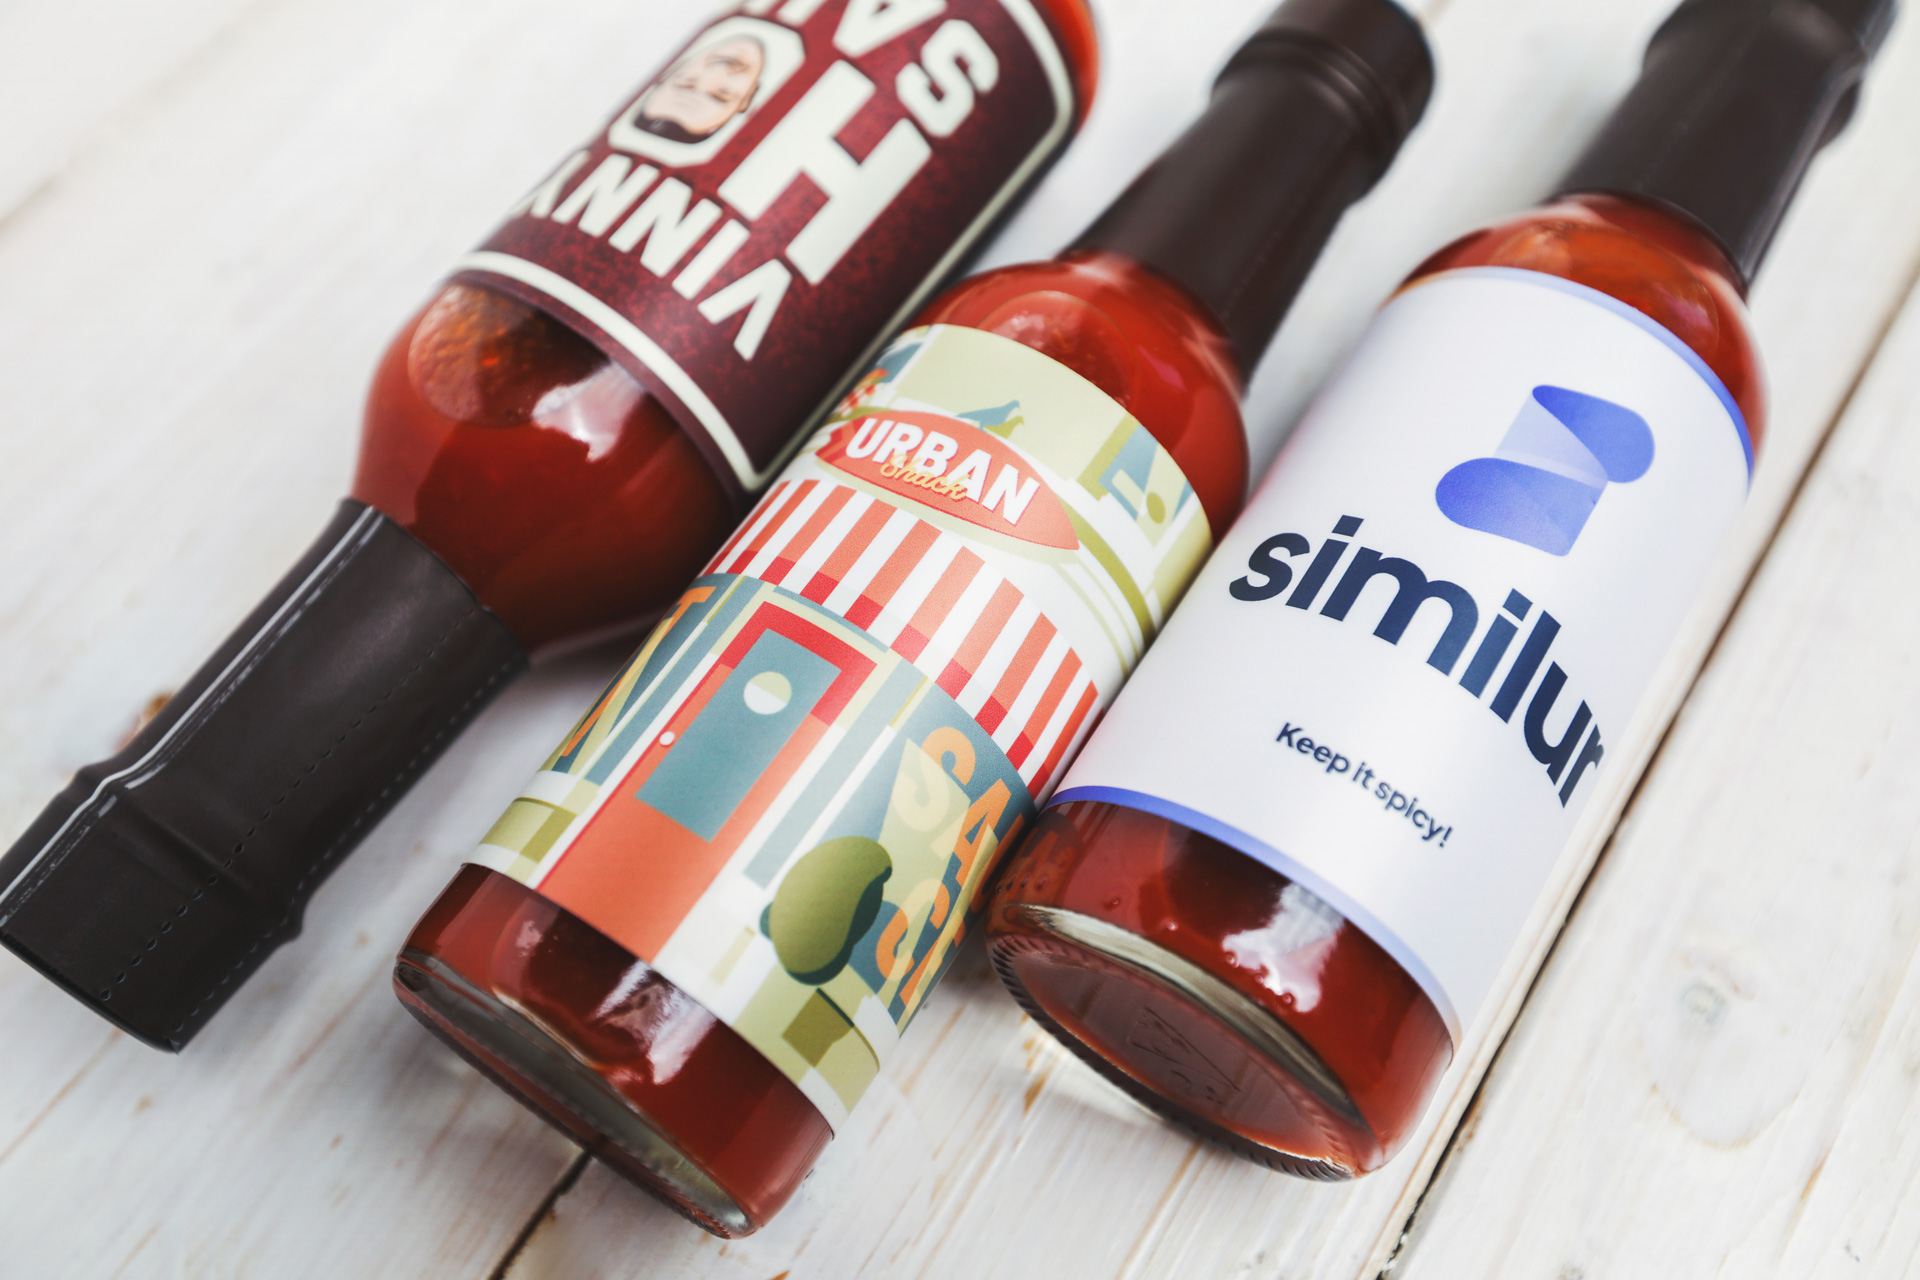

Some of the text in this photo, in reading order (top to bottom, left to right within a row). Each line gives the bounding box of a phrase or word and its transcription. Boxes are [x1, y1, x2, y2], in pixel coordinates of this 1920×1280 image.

[510, 149, 793, 361] VINNY
[845, 417, 1041, 527] URBAN
[880, 453, 973, 501] Shack
[1228, 514, 1605, 809] similur
[1276, 722, 1454, 849] Keep it spicy!
